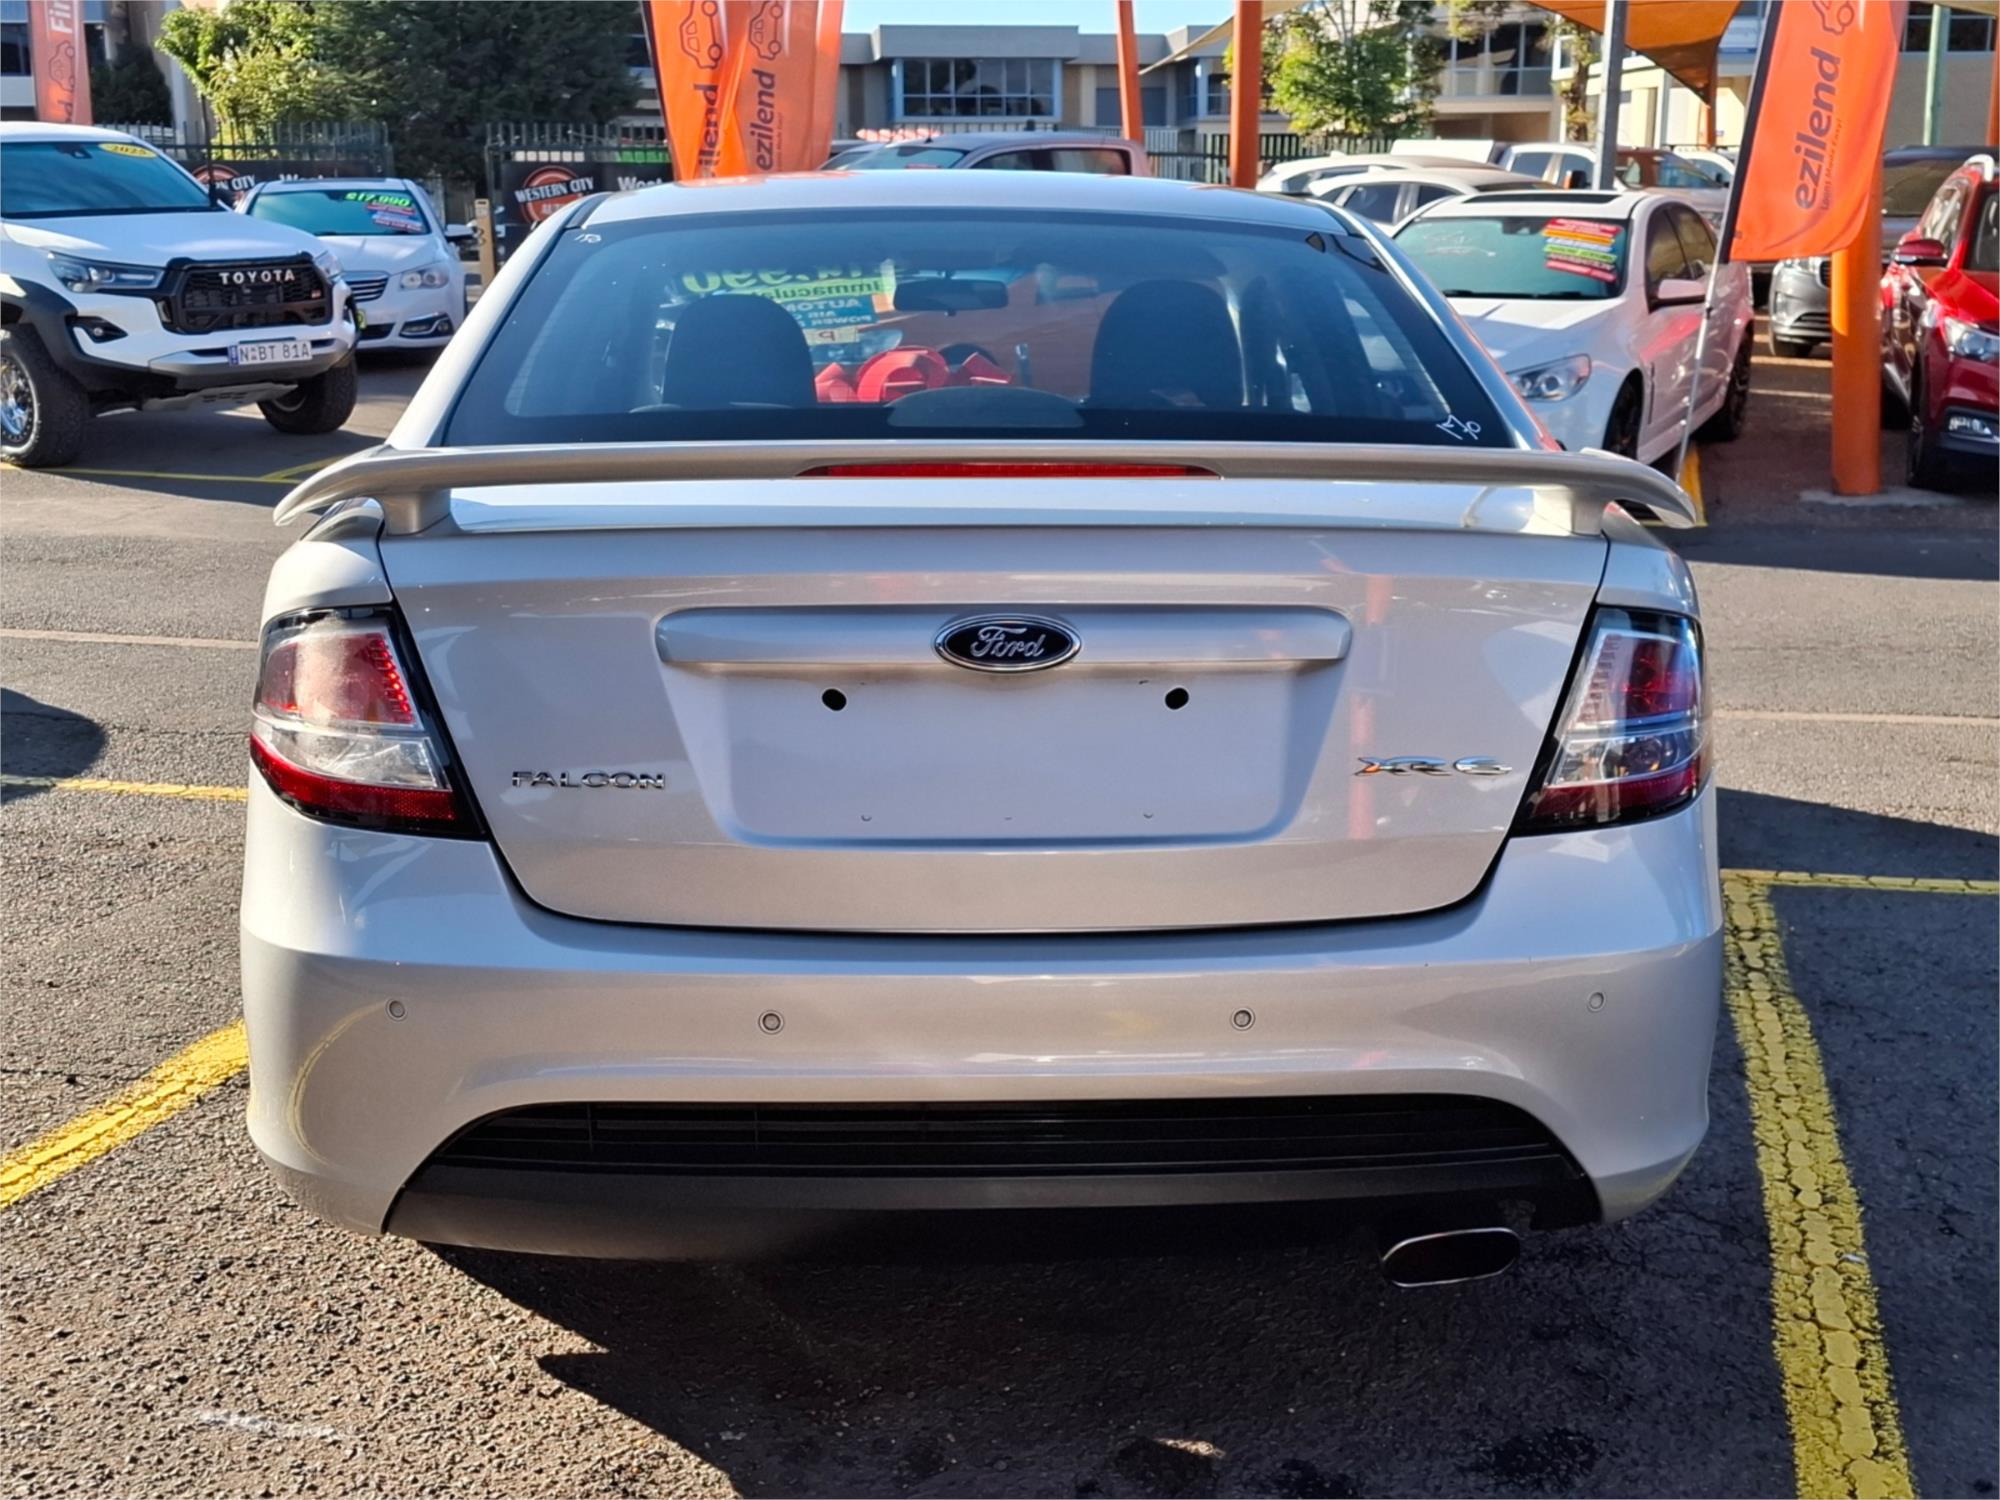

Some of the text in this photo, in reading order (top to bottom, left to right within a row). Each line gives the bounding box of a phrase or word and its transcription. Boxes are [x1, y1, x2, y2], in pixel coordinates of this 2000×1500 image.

[750, 69, 776, 171] ezilend
[1795, 47, 1841, 209] ezilend
[514, 176, 594, 203] WESTERN CITY
[219, 269, 296, 285] TOYOTA
[970, 625, 1046, 657] Ford
[1354, 755, 1513, 777] XR6
[511, 770, 665, 790] FALCON
